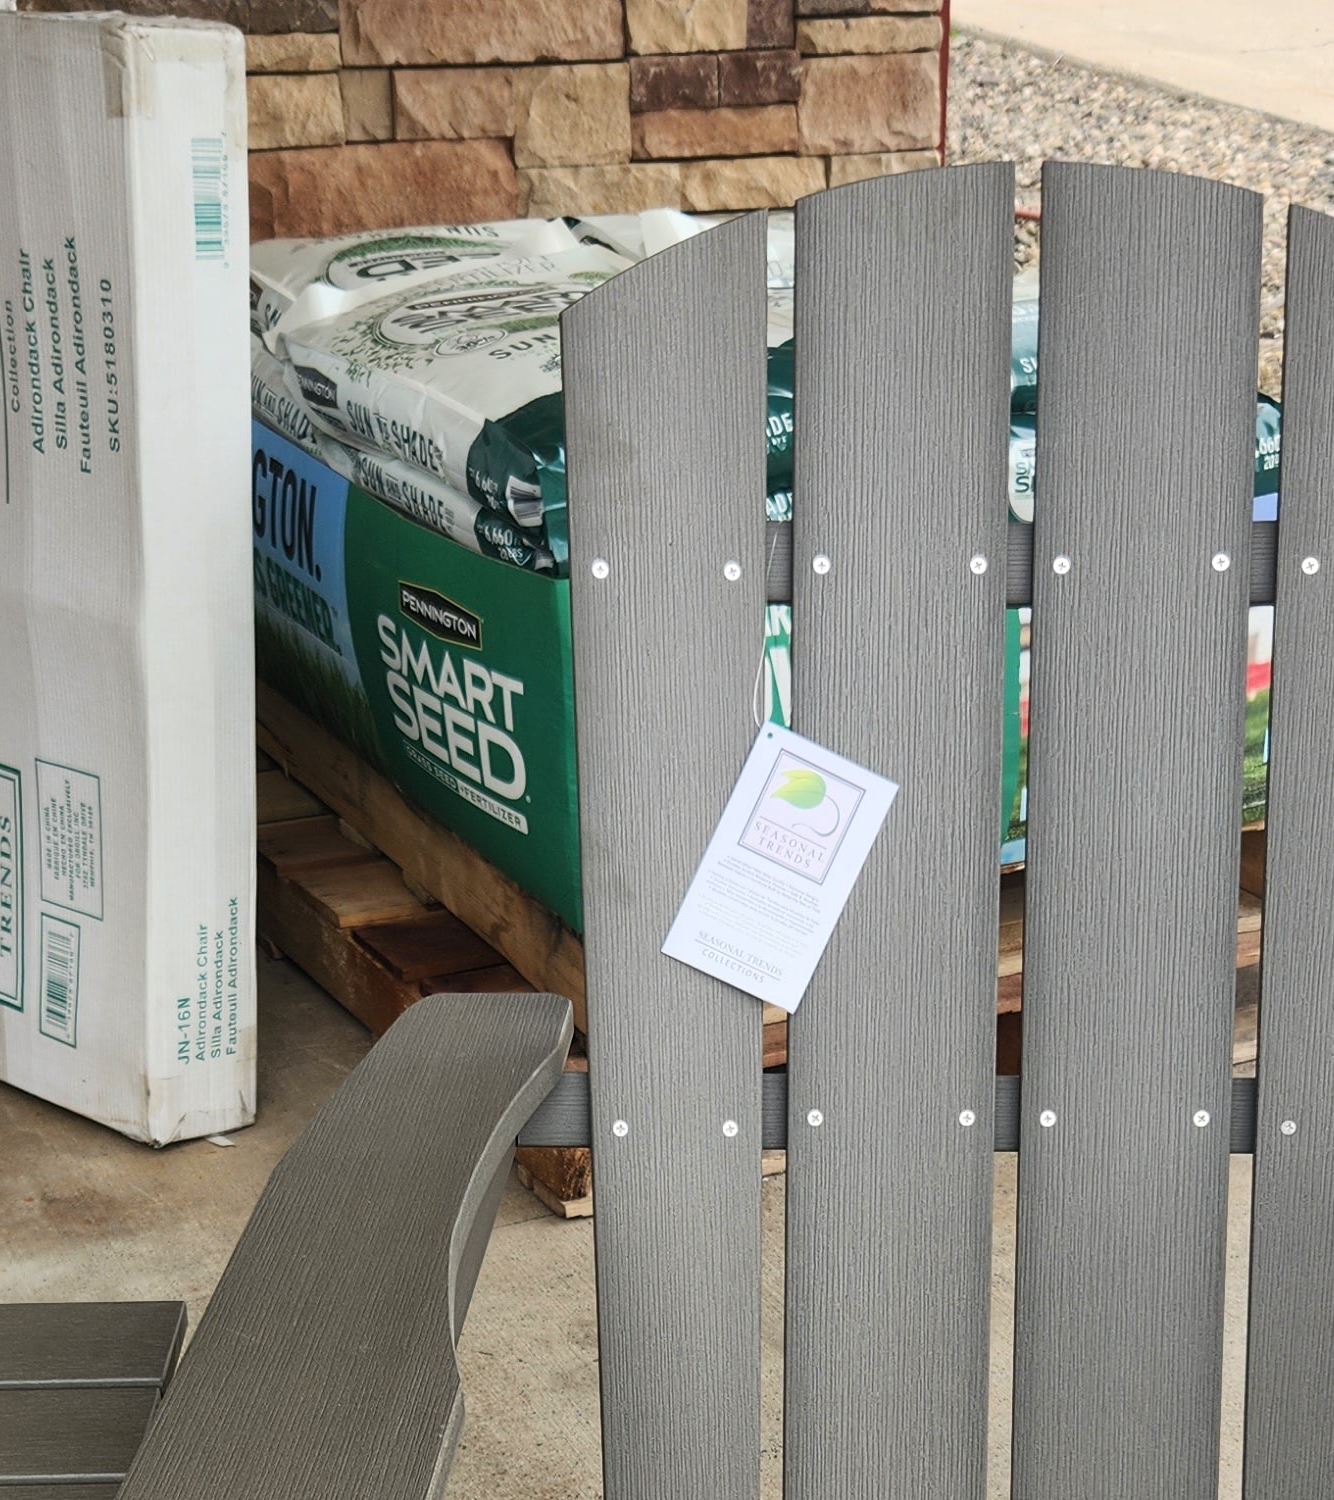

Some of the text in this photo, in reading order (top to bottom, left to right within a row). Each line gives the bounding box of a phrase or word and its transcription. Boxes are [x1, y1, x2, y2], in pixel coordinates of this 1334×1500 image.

[4, 300, 21, 413] Collection
[19, 248, 46, 455] Adirondack Chair
[42, 258, 68, 451] Silla Adirondack
[64, 236, 92, 475] Fauteuil Adirondack
[99, 279, 121, 453] SKU:5180310
[488, 332, 558, 361] SUN
[346, 399, 376, 440] SUN
[391, 420, 440, 472] SHADE
[361, 457, 386, 498] SUN
[402, 481, 448, 533] SHADE
[402, 589, 478, 641] PENNINGTON
[377, 613, 525, 733] SMART
[386, 669, 528, 801] SEED
[434, 763, 458, 791] SEED
[0, 815, 13, 958] TRENDS
[754, 821, 824, 862] SEASONAL
[759, 836, 811, 869] TRENDS
[195, 924, 209, 1062] Adirondack Chair
[210, 930, 224, 1058] Silla Adirondack
[226, 896, 239, 1056] Fauteuil Adirondack
[698, 929, 783, 977] SEASONAL TRENDS
[701, 947, 766, 984] COLLECTIONS
[177, 998, 192, 1065] JN-16N
